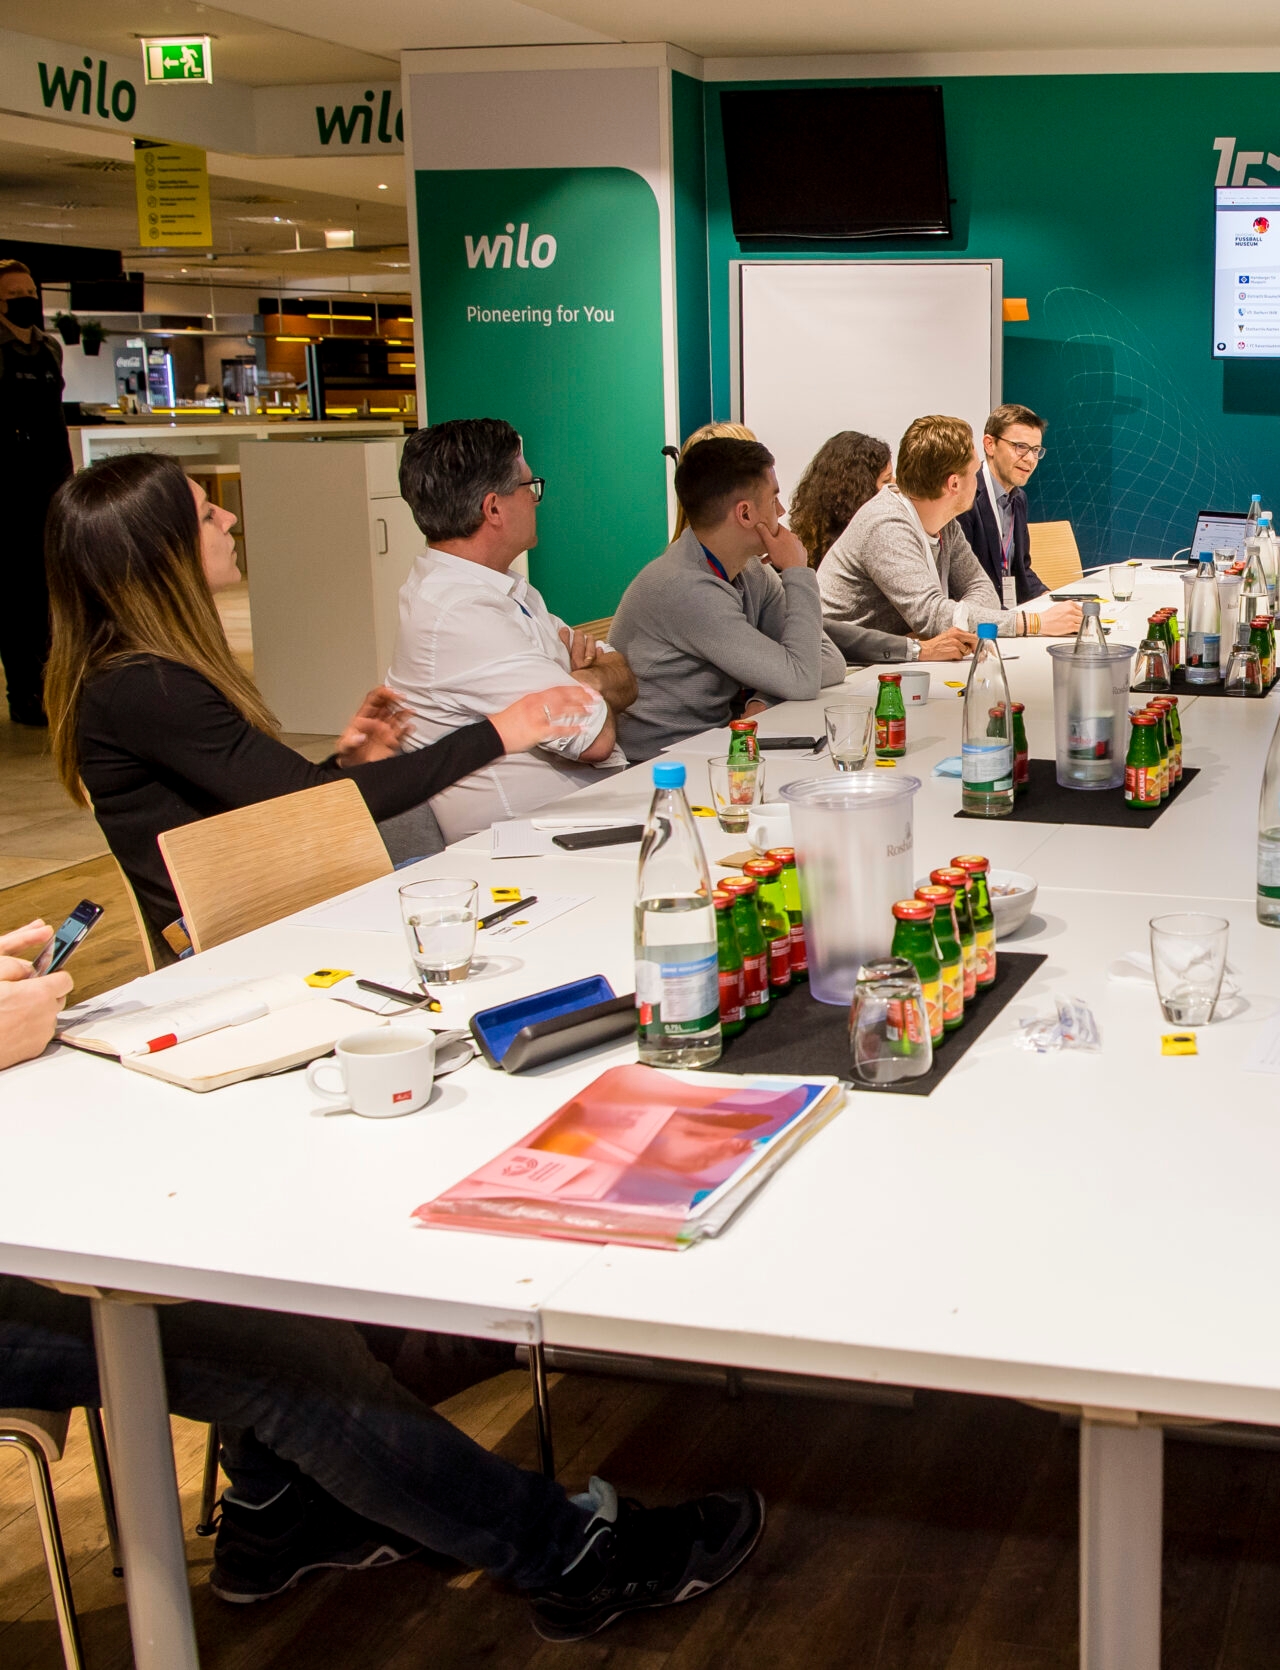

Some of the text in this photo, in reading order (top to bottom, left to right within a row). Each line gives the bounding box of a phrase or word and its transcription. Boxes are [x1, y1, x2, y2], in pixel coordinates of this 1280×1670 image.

[38, 56, 136, 122] wilo
[464, 222, 557, 269] wilo
[466, 304, 615, 327] Pioneering for You
